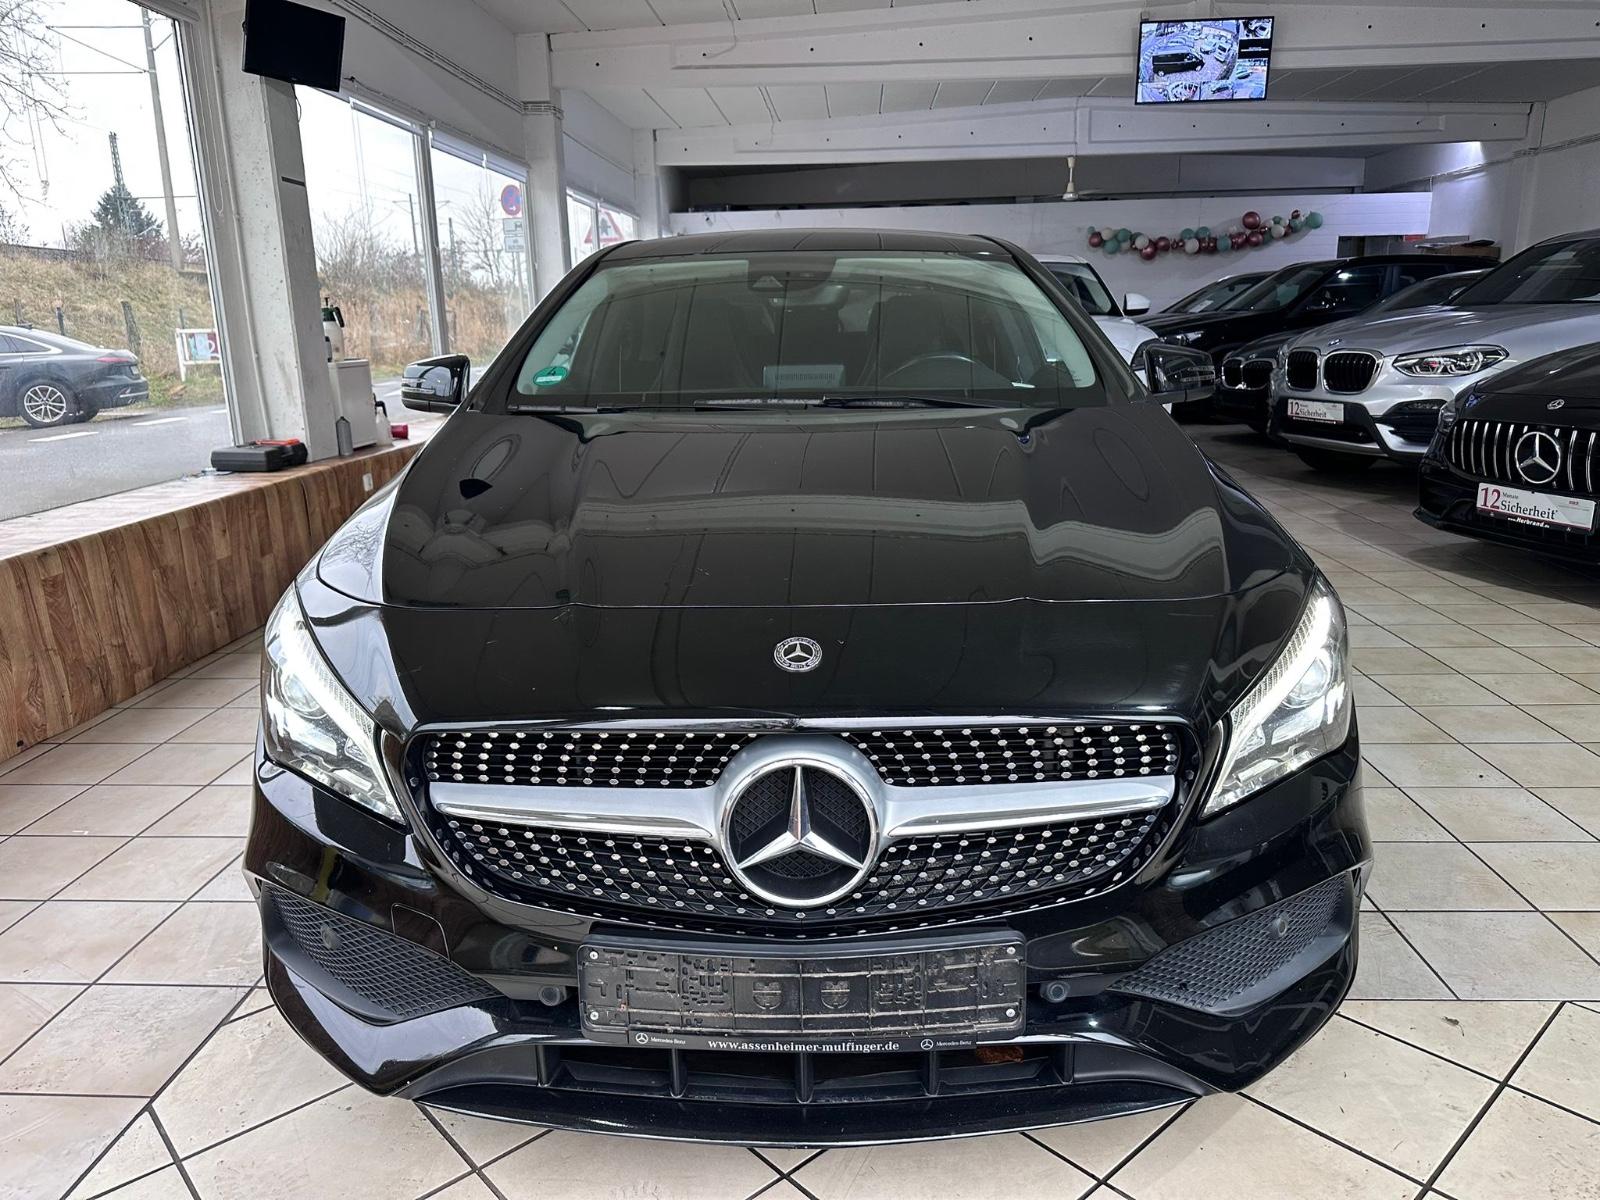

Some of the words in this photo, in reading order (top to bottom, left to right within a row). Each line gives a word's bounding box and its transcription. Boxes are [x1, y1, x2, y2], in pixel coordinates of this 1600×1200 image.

[1290, 402, 1300, 415] 12
[1480, 487, 1501, 509] 12
[708, 1040, 900, 1054] www.assenheimer-mulfinger.de
